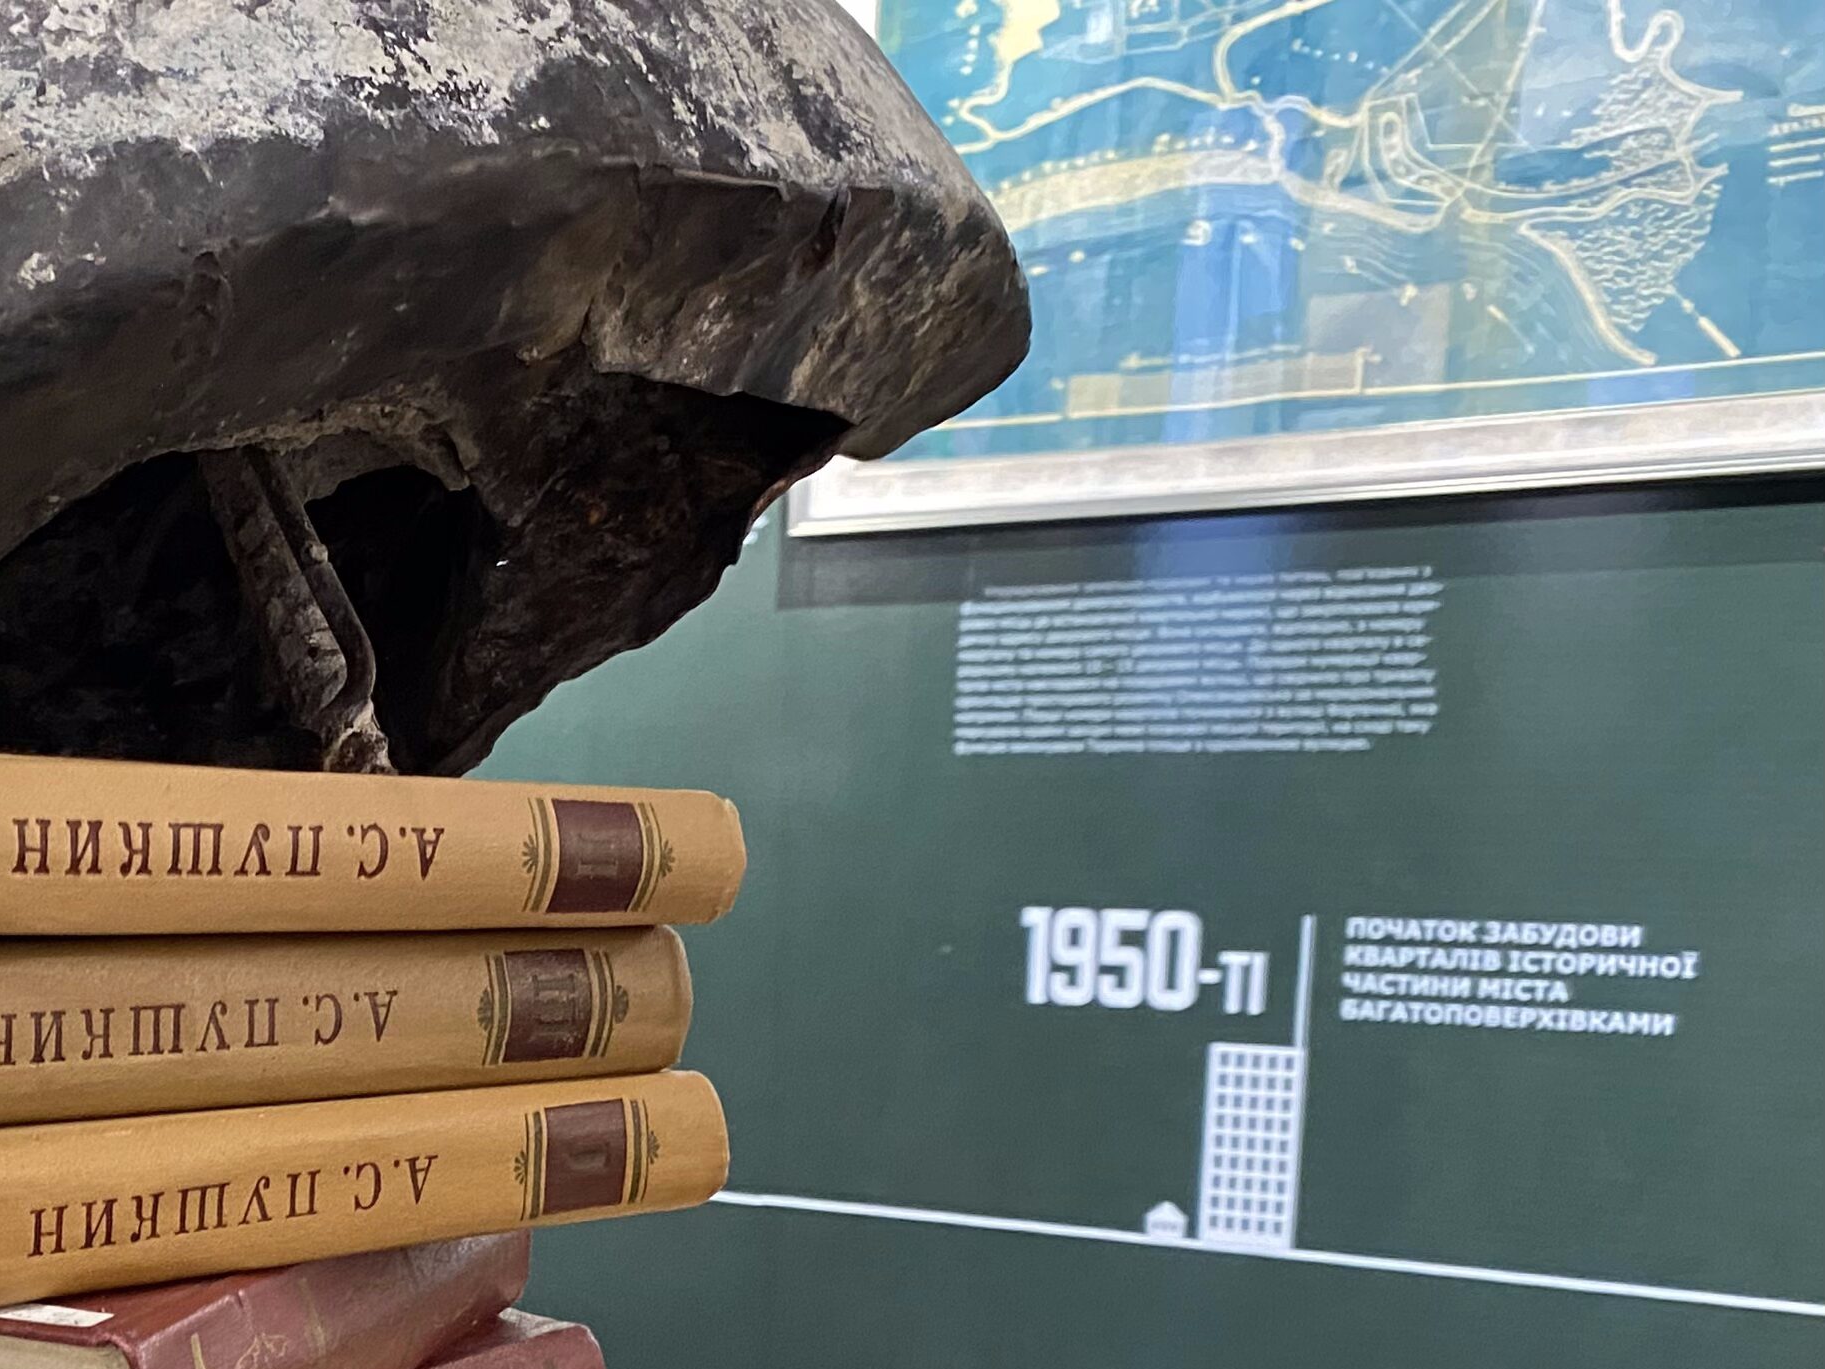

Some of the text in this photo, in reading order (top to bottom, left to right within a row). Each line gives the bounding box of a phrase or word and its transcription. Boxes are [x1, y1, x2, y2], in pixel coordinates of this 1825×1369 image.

[11, 818, 323, 877] ПУШКИН
[1345, 916, 1644, 949] ПОЧАТОК ЗАБУДОВИ
[1343, 944, 1700, 979] КВАРТАЛІВ ІСТОРИЧНОЇ
[1341, 971, 1569, 1002] ЧАСТИНИ МІСТА
[1339, 998, 1675, 1036] БАГАТОПОВЕРХІВКАМИ
[27, 1170, 321, 1257] ПУШКИН
